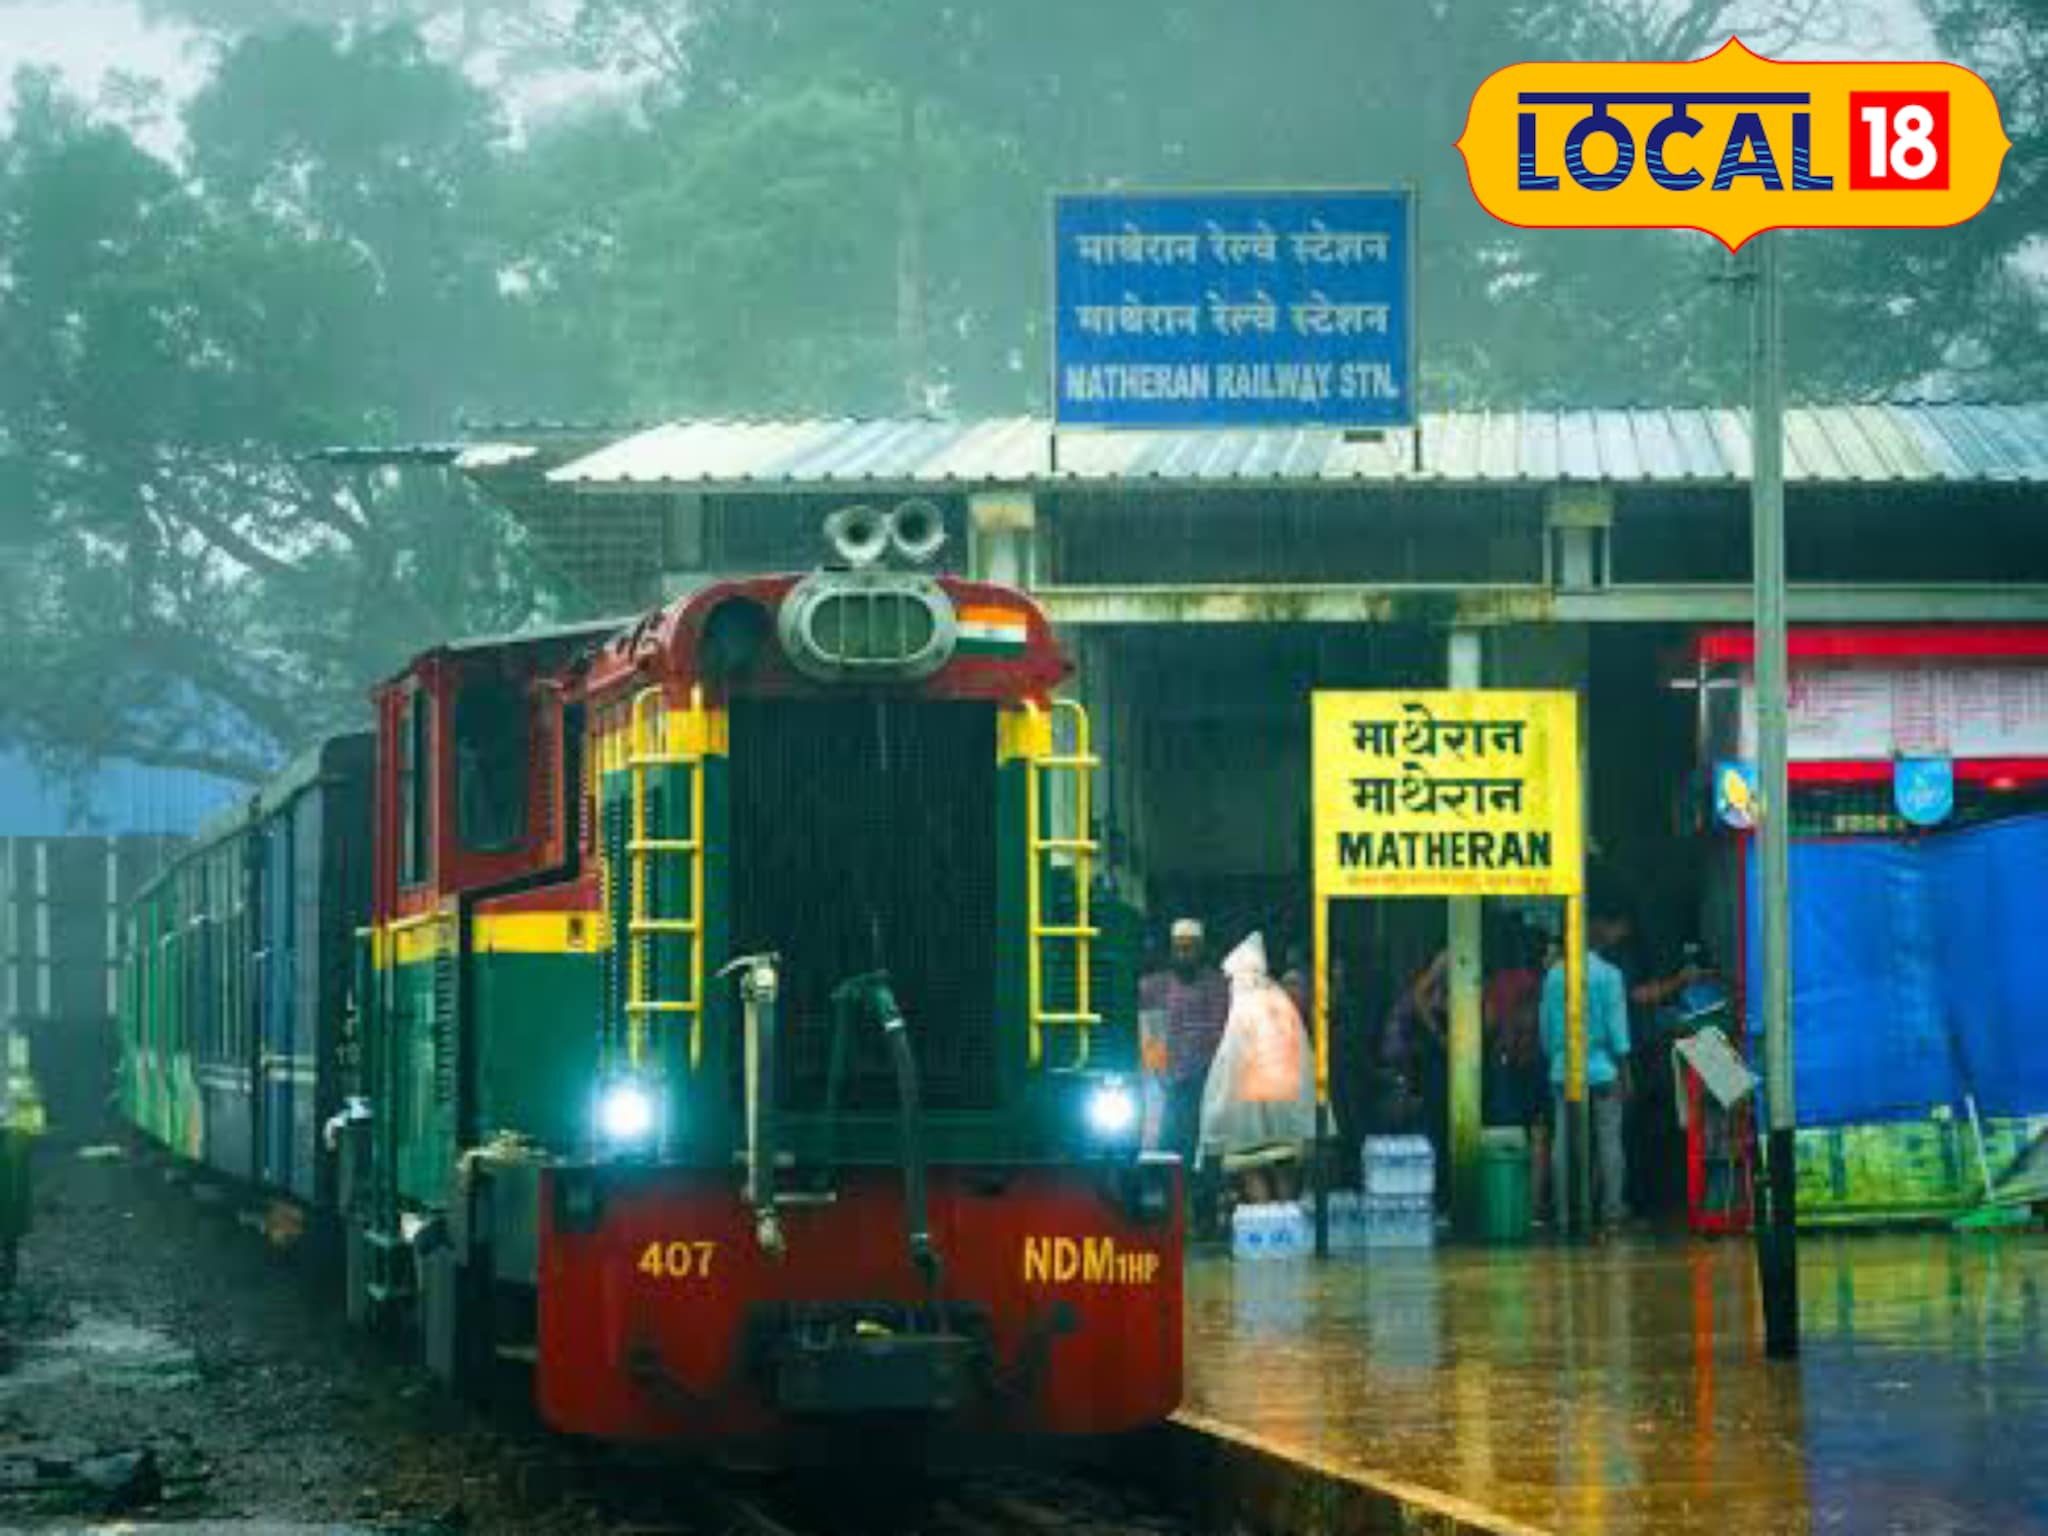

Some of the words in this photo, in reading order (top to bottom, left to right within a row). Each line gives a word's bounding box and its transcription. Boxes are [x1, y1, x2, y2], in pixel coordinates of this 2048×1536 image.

[1066, 363, 1209, 399] MATHERAN
[1216, 363, 1332, 400] RAILWAY
[1350, 703, 1527, 761] माथेरान
[1350, 761, 1524, 818] माथेरान
[1337, 831, 1552, 869] MATHERAN
[639, 1241, 713, 1278] 407
